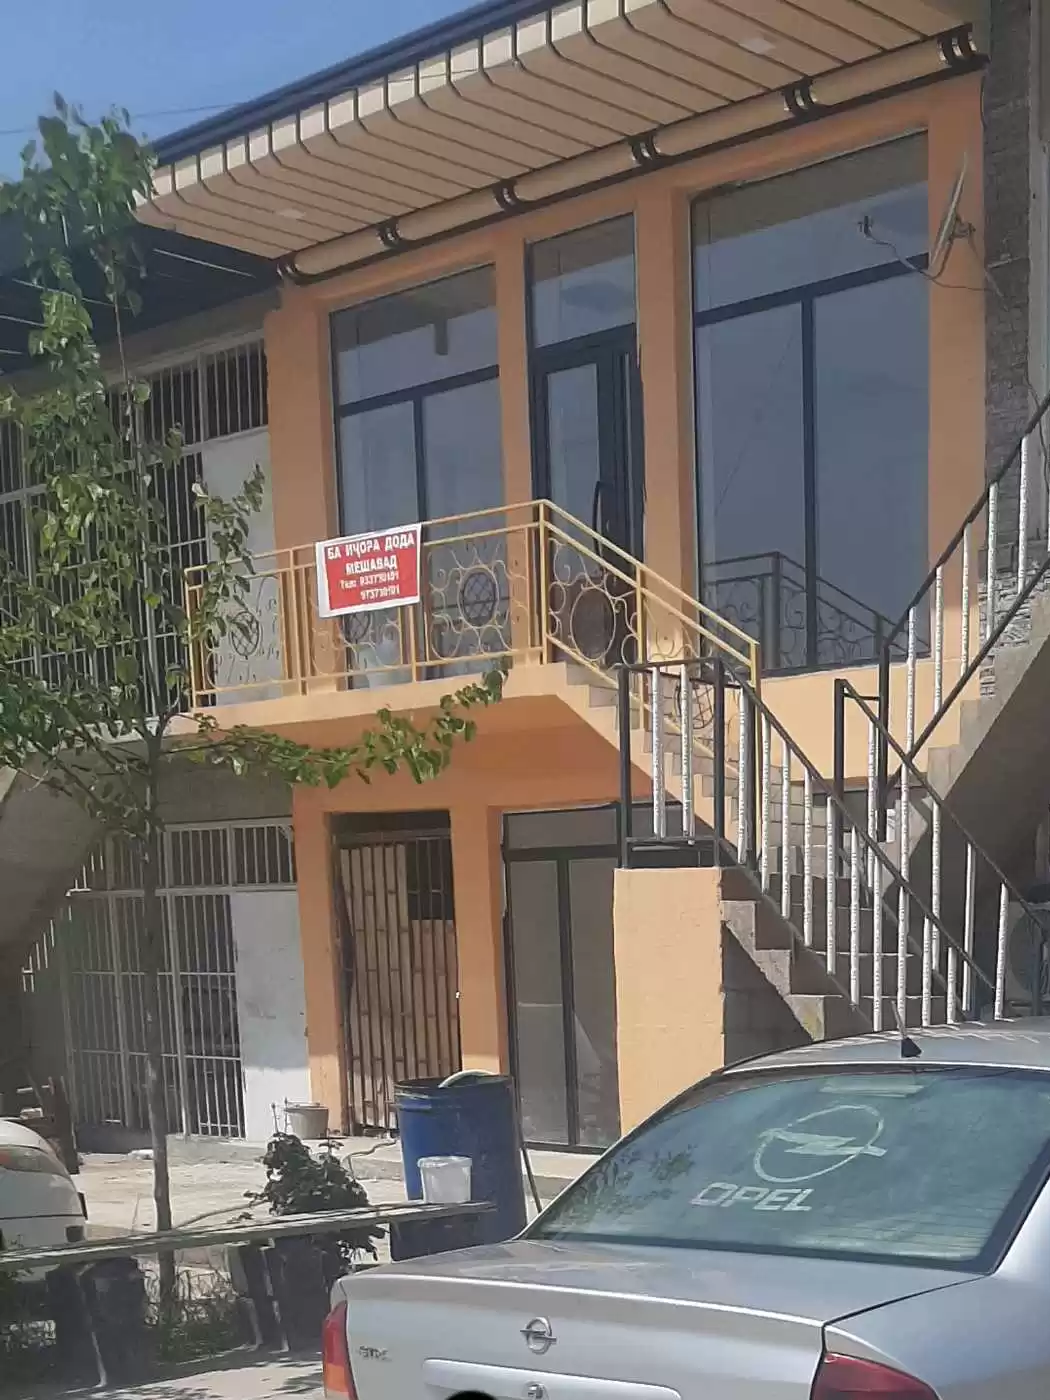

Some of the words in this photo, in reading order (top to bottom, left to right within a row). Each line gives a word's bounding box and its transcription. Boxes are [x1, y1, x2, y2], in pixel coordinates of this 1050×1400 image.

[327, 547, 341, 559] БА
[385, 533, 414, 551] ДОДА
[346, 555, 398, 574] МЕШАВАД
[689, 1182, 815, 1212] OPEL
